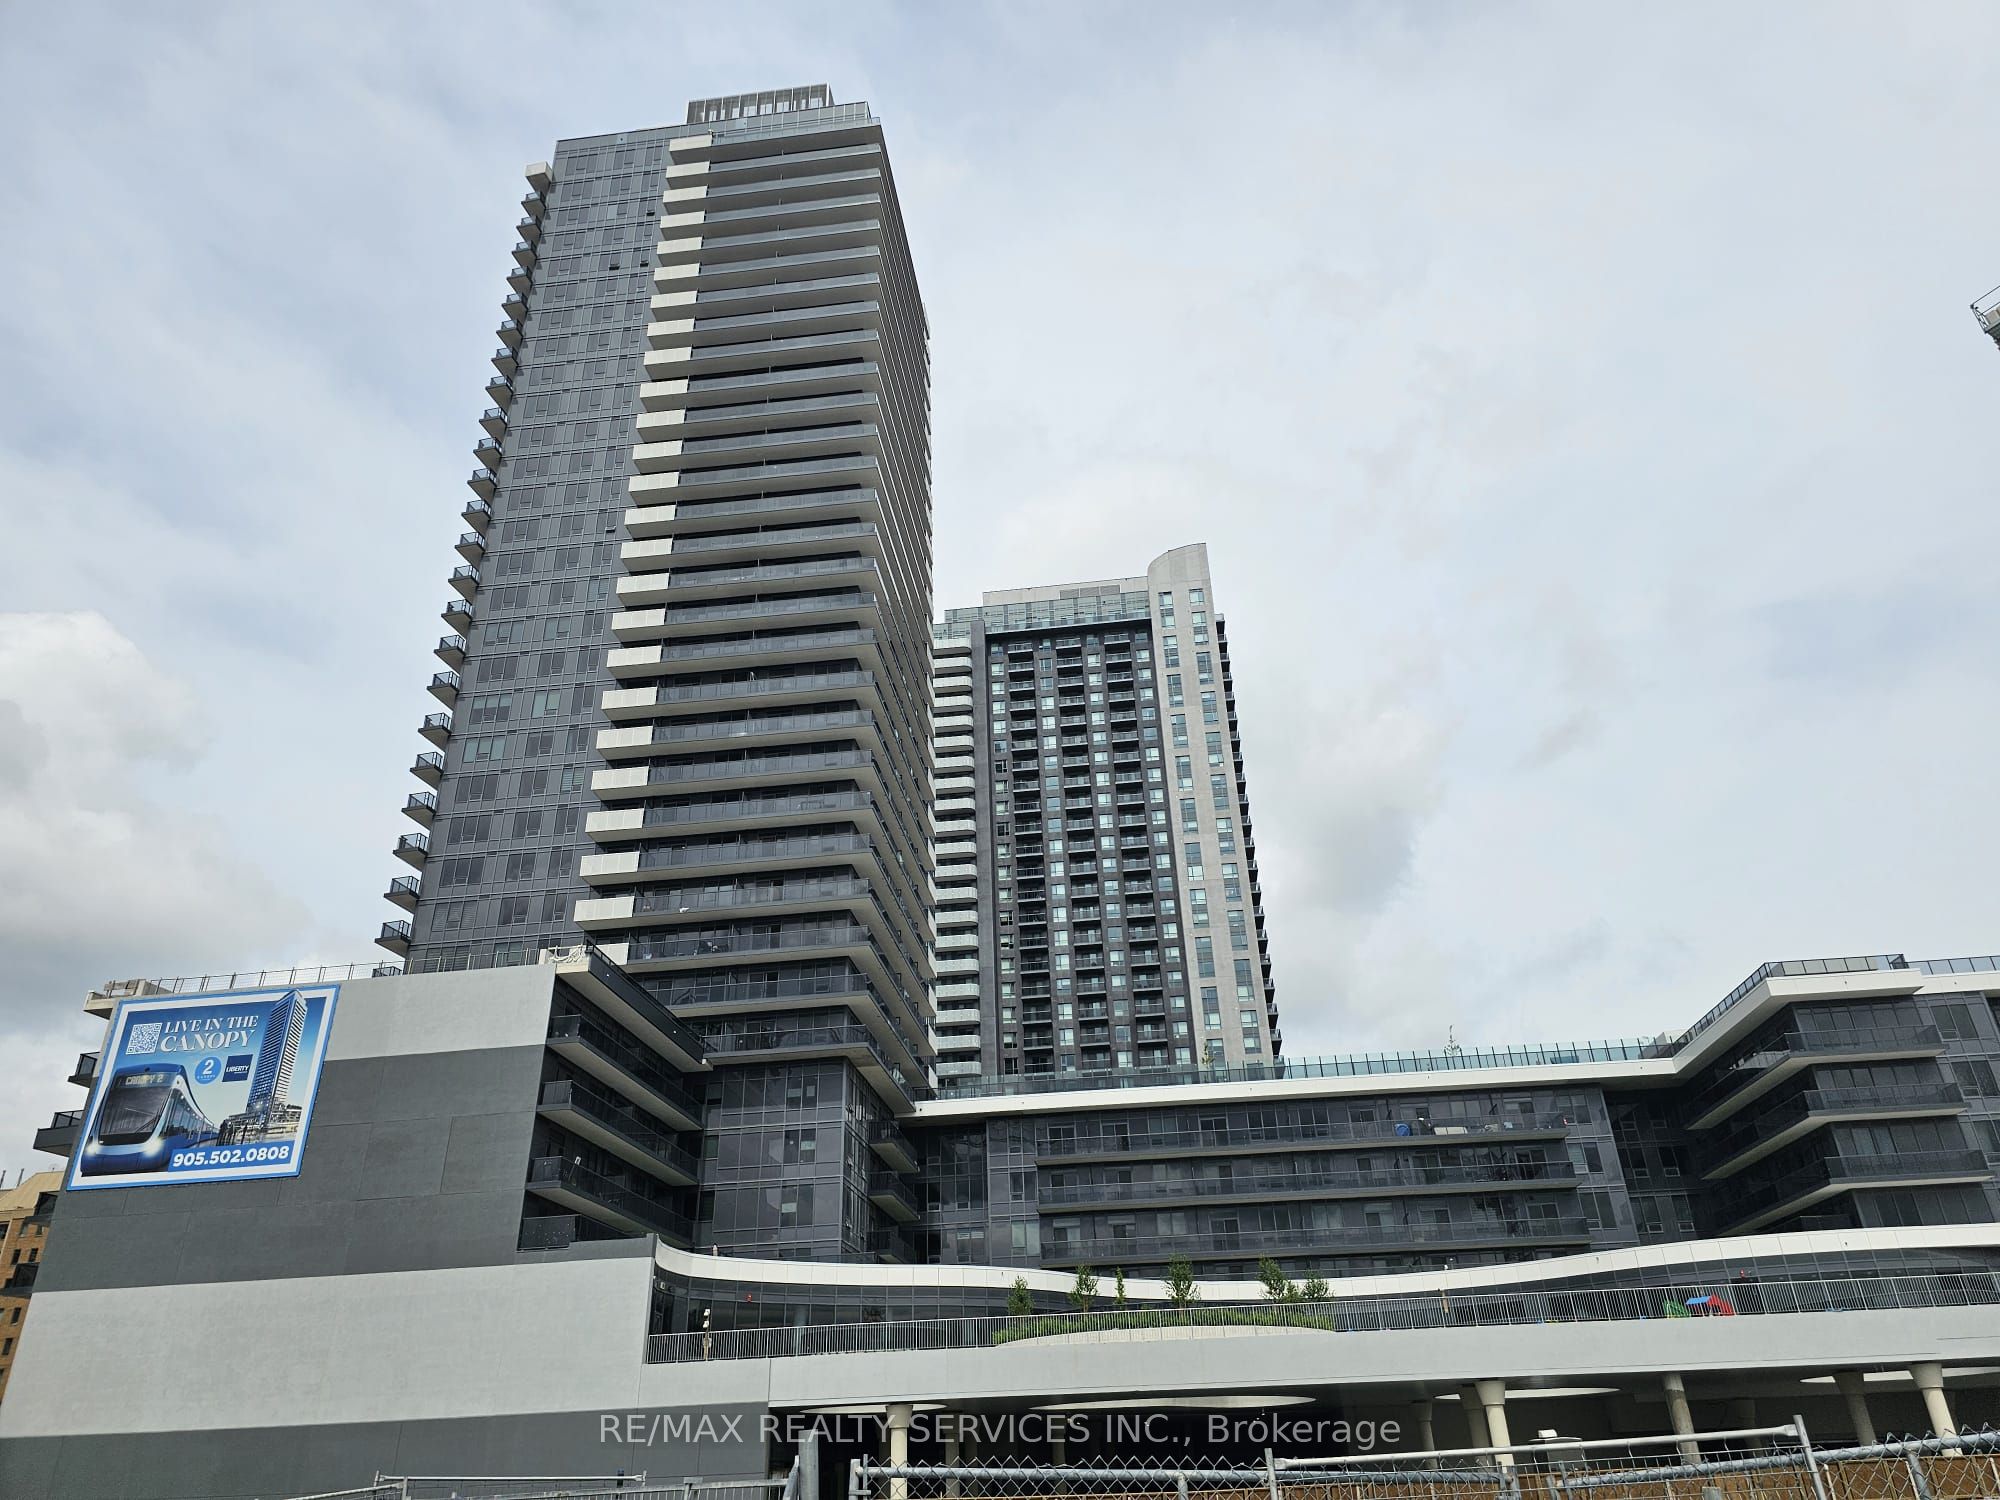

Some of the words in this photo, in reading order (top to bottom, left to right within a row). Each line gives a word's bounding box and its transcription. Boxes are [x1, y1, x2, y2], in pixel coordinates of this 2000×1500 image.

[164, 1020, 201, 1033] LIVE
[205, 1018, 223, 1030] IN
[227, 1015, 258, 1028] THE
[160, 1029, 255, 1052] CANOPY
[203, 1059, 214, 1074] 2
[173, 1145, 289, 1166] 905.502.0808
